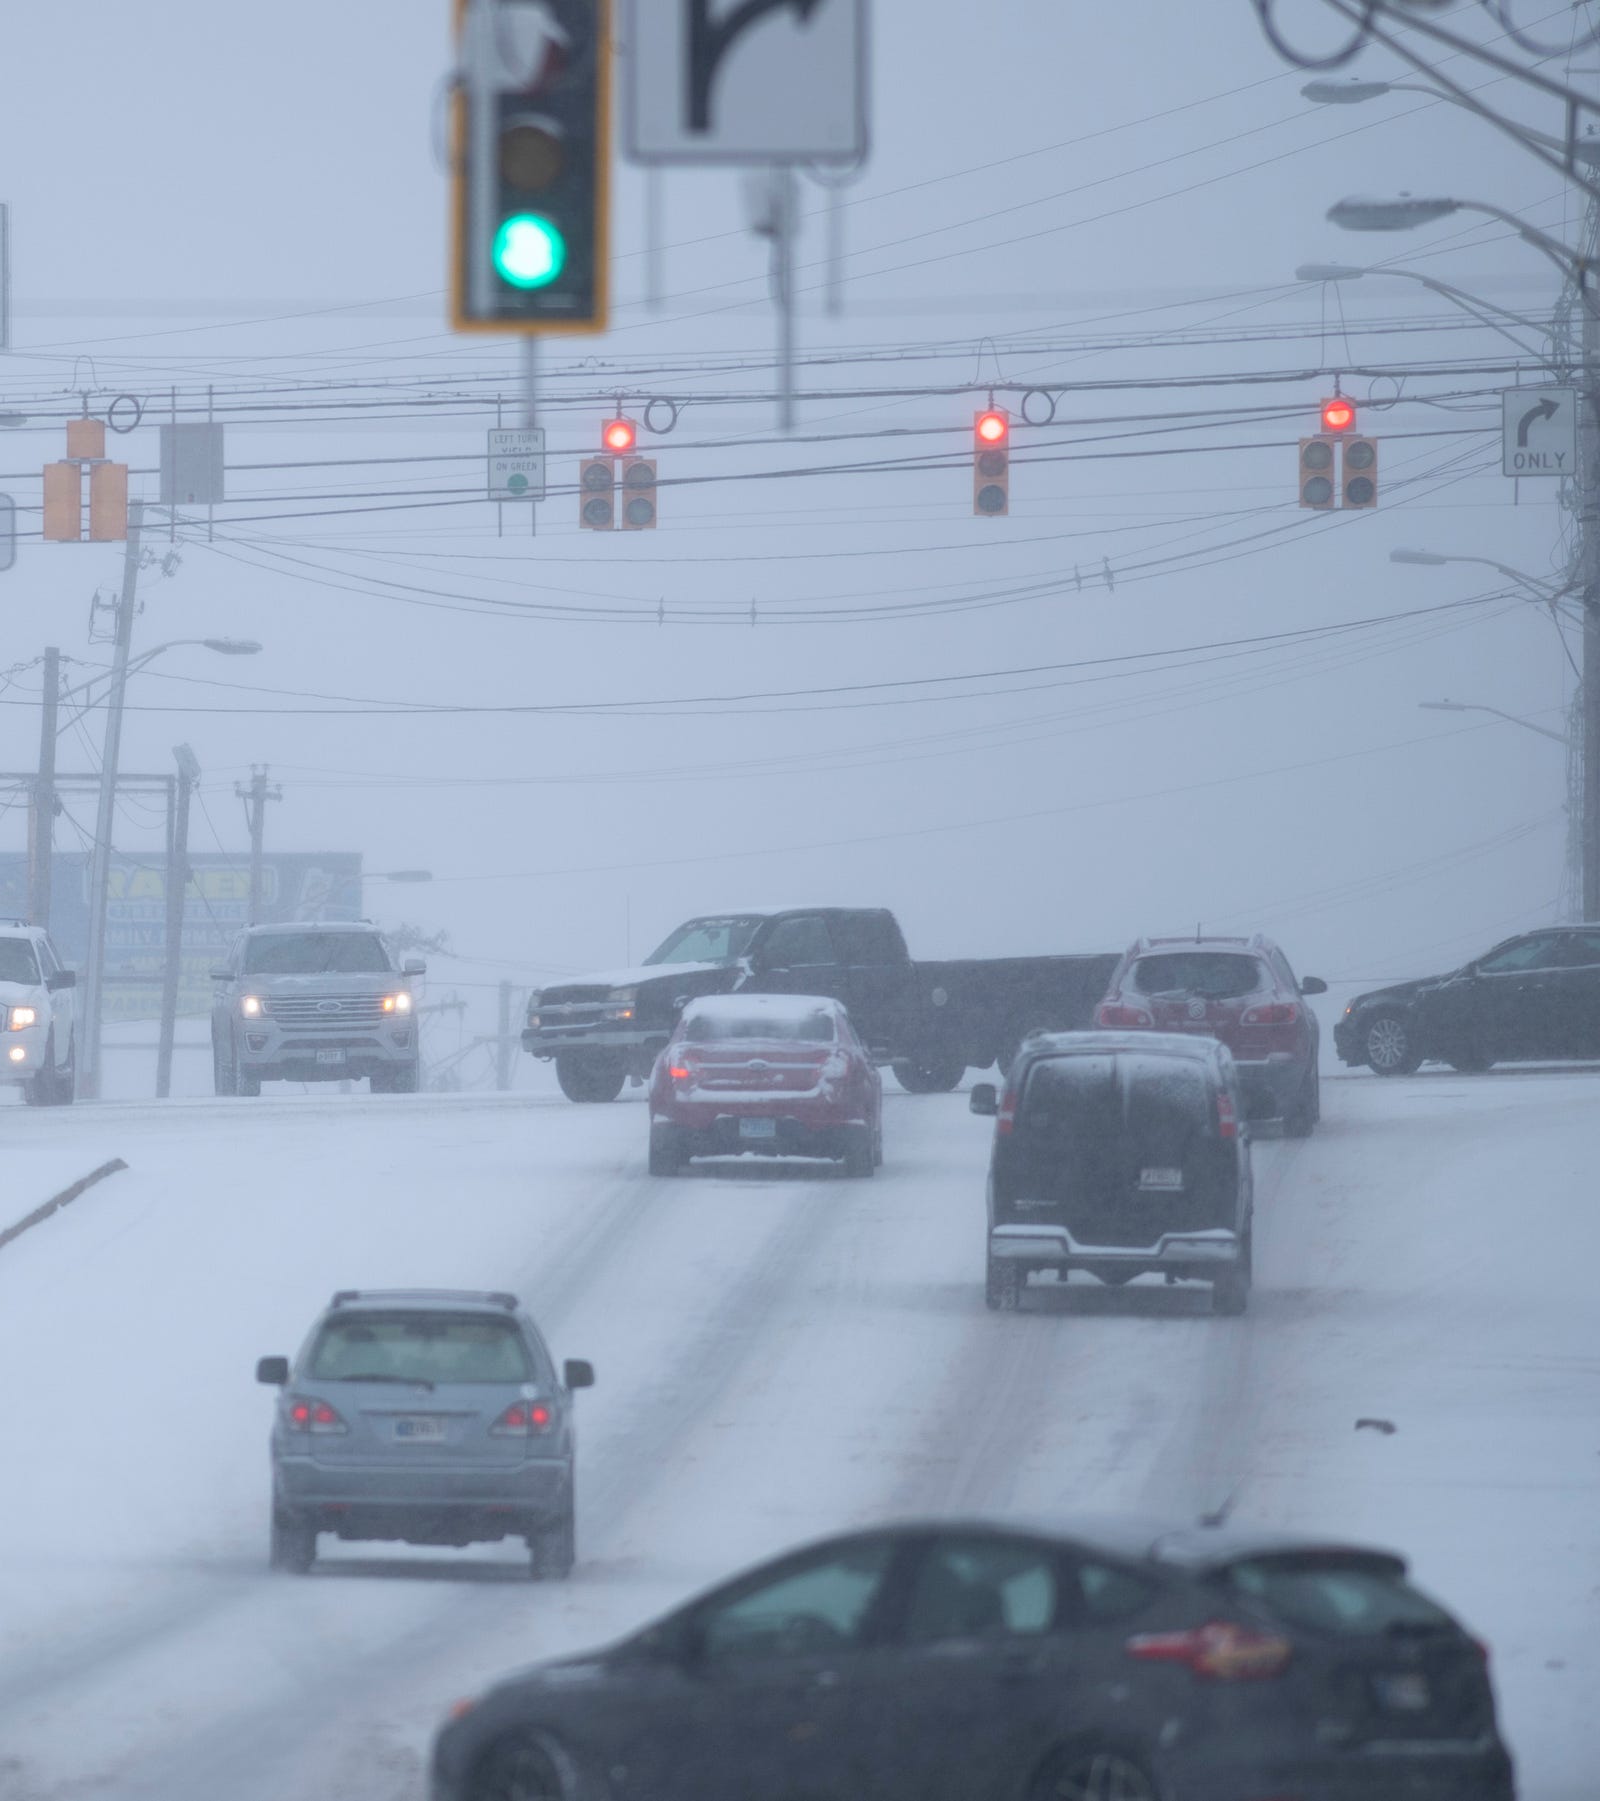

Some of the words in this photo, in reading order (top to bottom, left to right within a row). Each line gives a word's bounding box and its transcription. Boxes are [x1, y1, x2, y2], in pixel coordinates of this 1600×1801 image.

[494, 435, 514, 444] LEFT
[517, 434, 539, 443] TURN
[1513, 452, 1566, 469] ONLY
[496, 463, 508, 471] ON
[510, 462, 538, 471] GREEN
